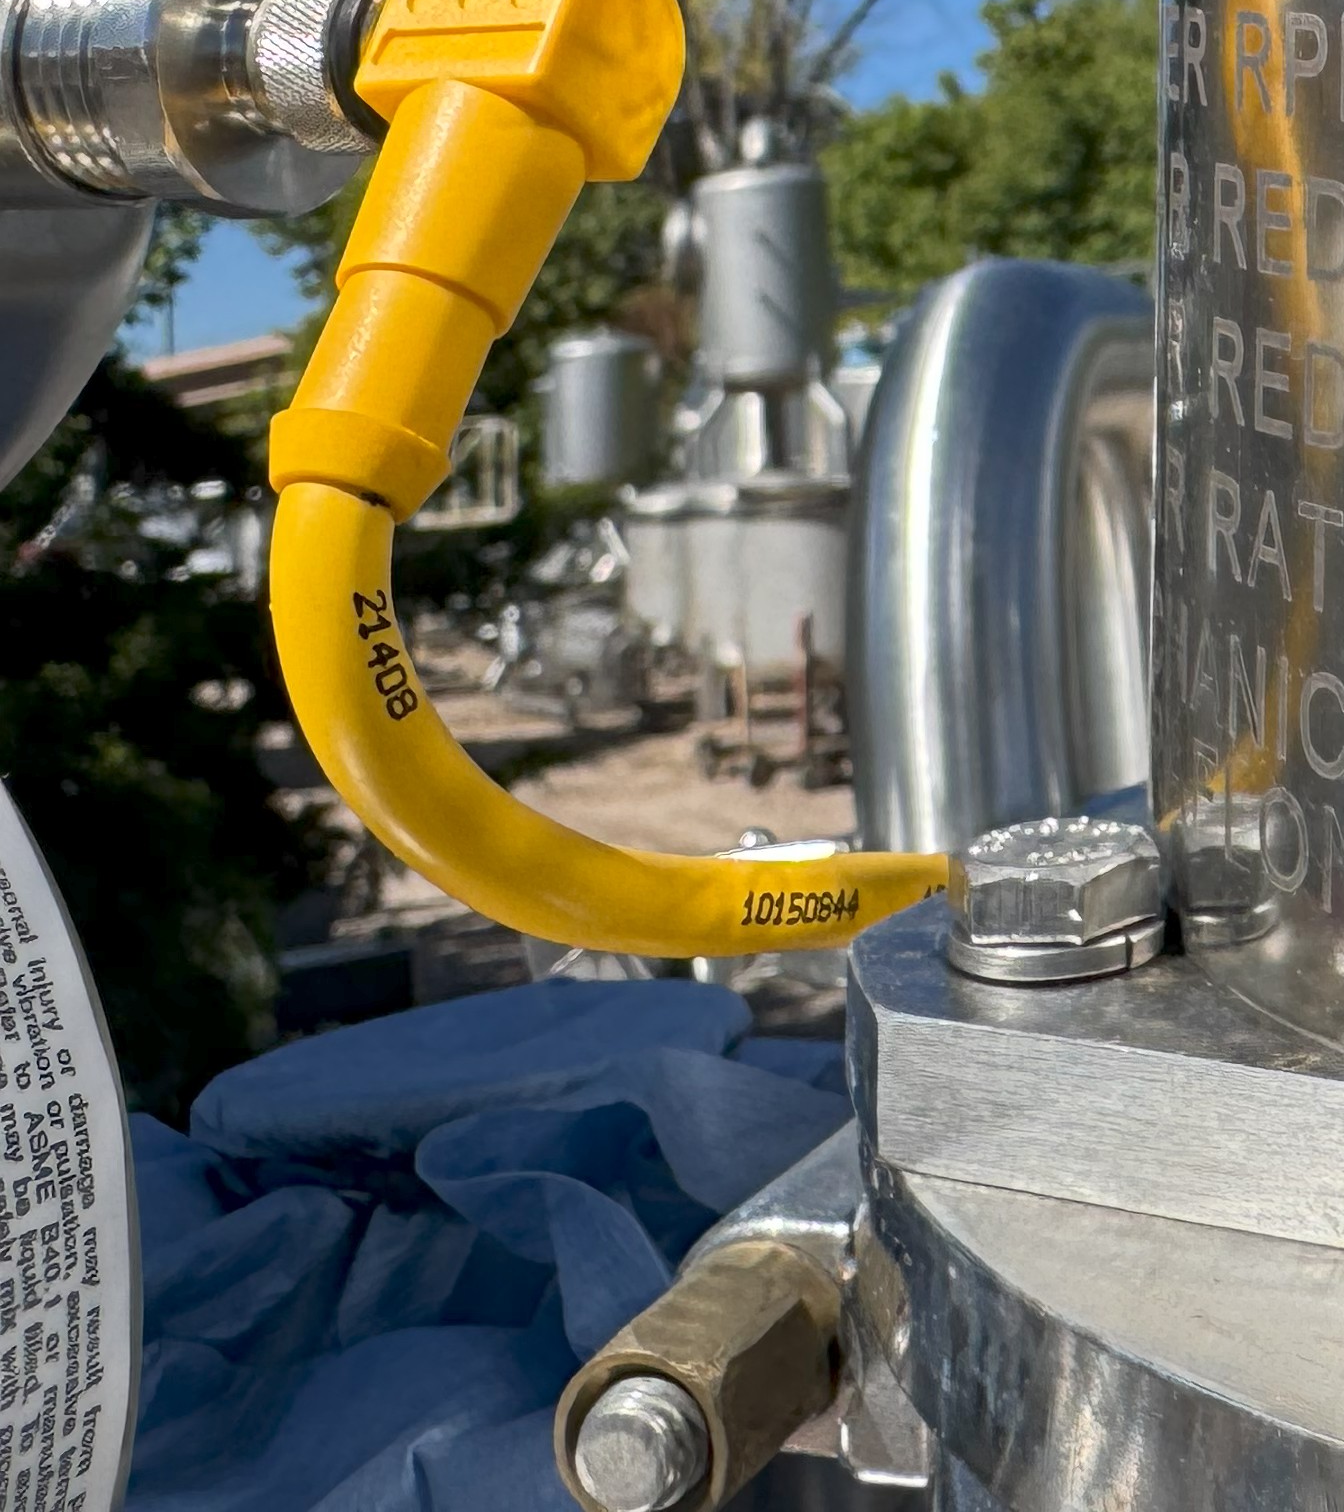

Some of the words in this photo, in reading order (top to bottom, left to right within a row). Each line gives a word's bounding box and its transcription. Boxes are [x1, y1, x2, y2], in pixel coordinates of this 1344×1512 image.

[353, 589, 418, 721] 21408
[13, 973, 55, 1090] vibration
[47, 1100, 64, 1129] or
[57, 1048, 76, 1077] or
[0, 1103, 24, 1162] may
[13, 1176, 33, 1217] be
[69, 1093, 95, 1210] damage
[14, 1060, 31, 1090] to
[23, 1111, 56, 1205] ASME
[45, 1331, 60, 1364] or
[81, 1226, 100, 1286] may
[76, 1404, 102, 1478] from
